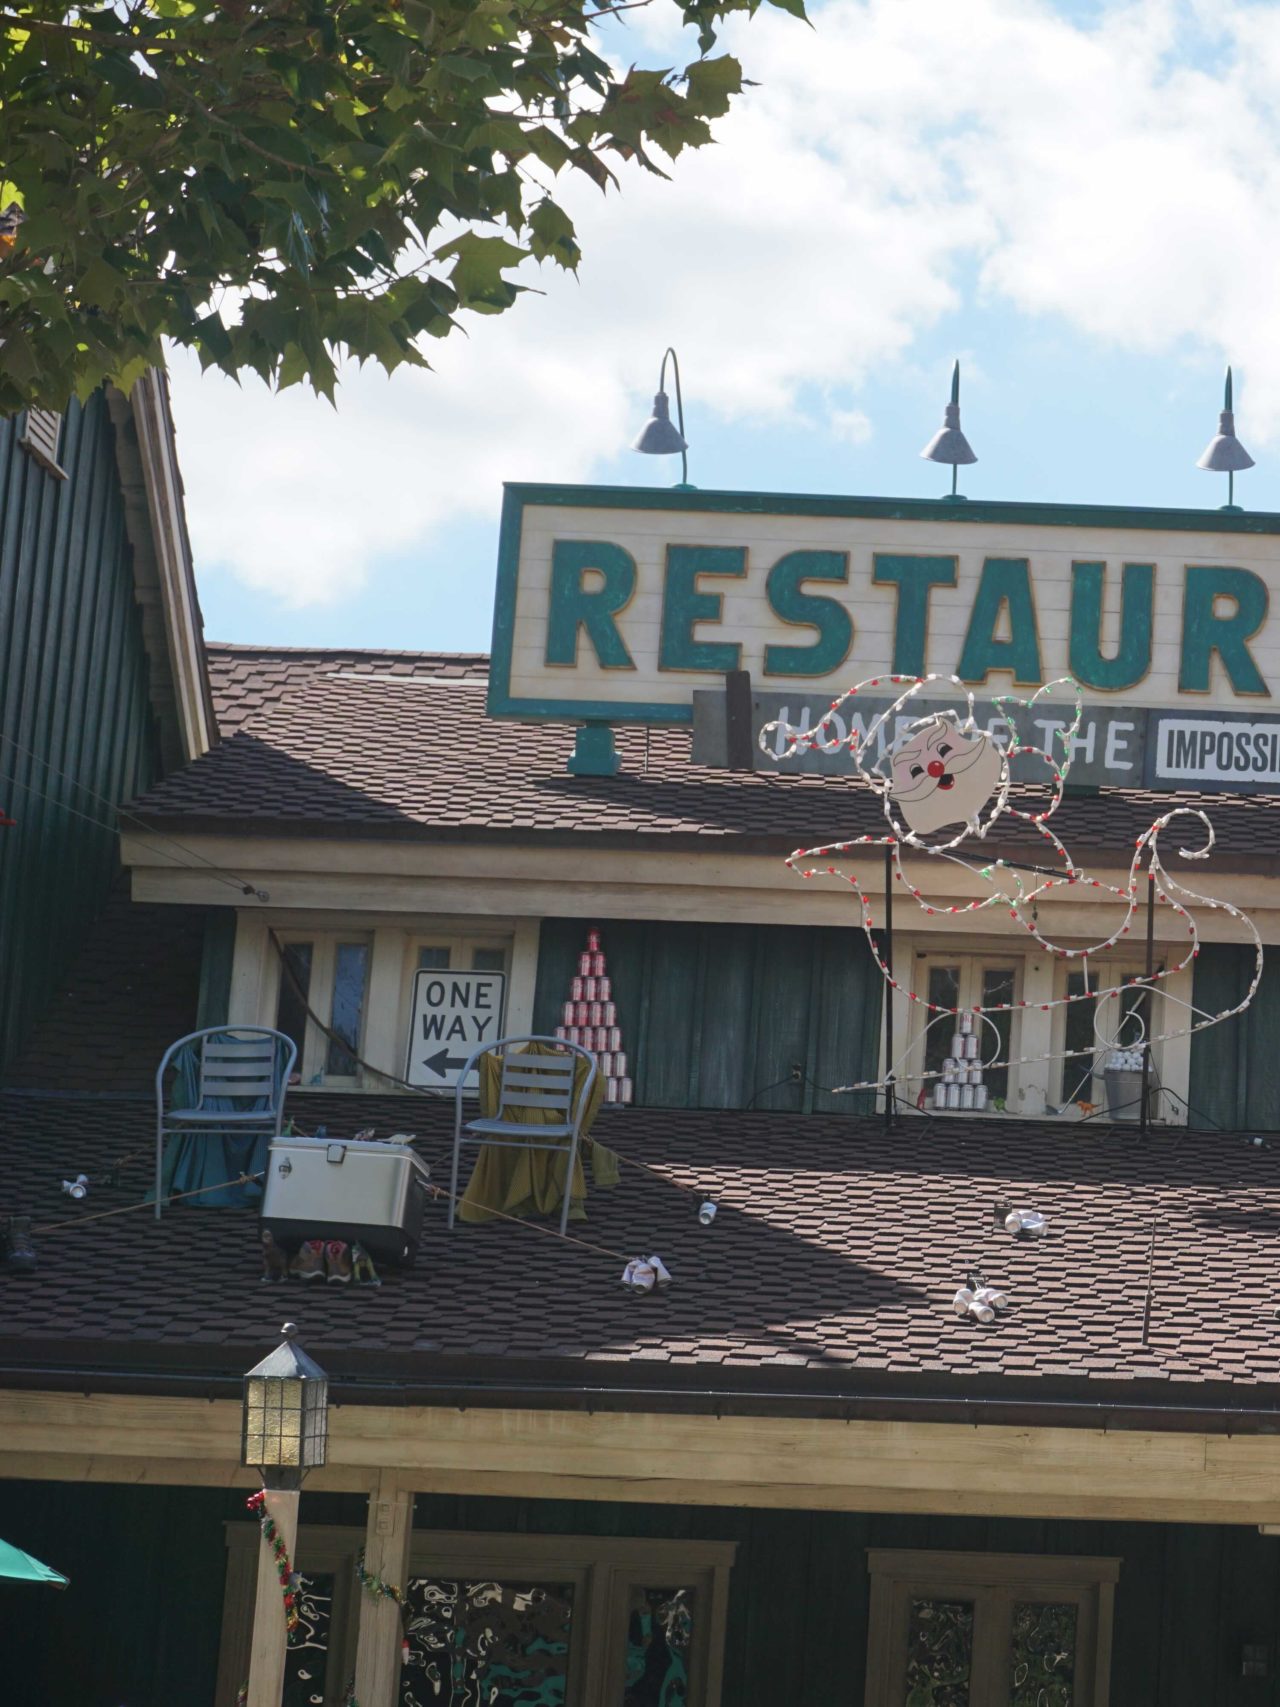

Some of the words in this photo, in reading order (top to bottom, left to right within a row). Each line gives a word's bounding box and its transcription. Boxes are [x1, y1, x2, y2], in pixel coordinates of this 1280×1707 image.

[1033, 718, 1136, 772] THE
[425, 980, 493, 1009] ONE
[422, 1013, 493, 1042] WAY
